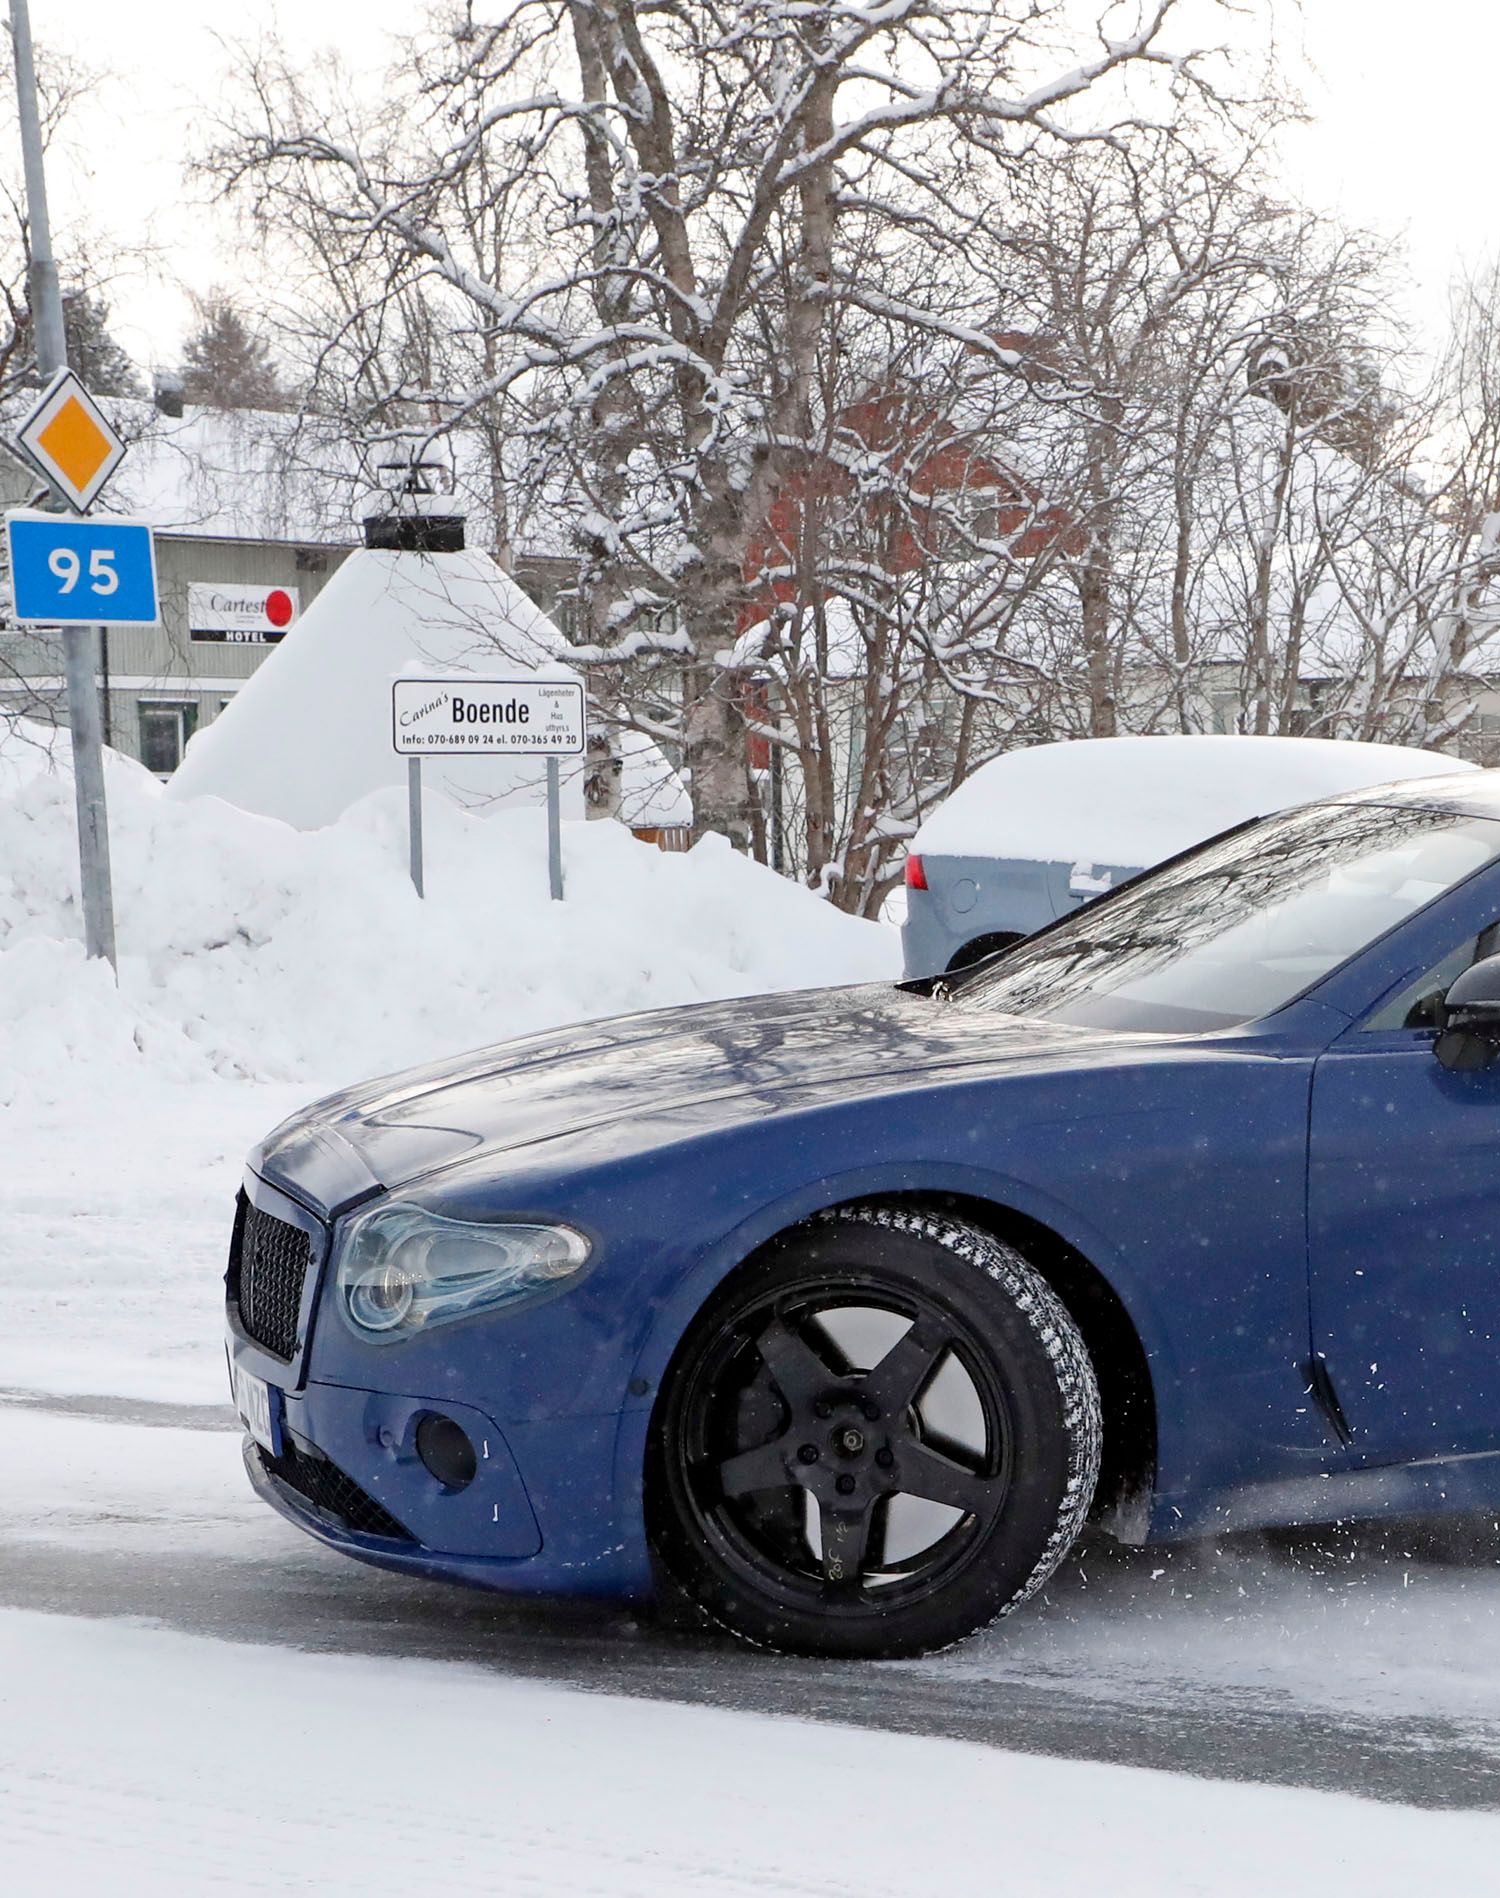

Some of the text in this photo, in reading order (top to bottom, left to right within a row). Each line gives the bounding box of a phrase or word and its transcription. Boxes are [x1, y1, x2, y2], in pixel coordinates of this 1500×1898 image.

[47, 547, 120, 596] 95
[225, 631, 267, 642] HOTEL
[399, 690, 449, 727] Carina's
[452, 697, 530, 724] Boende
[402, 734, 577, 745] Info: 070-689 09 24 el. 070-365 49 20
